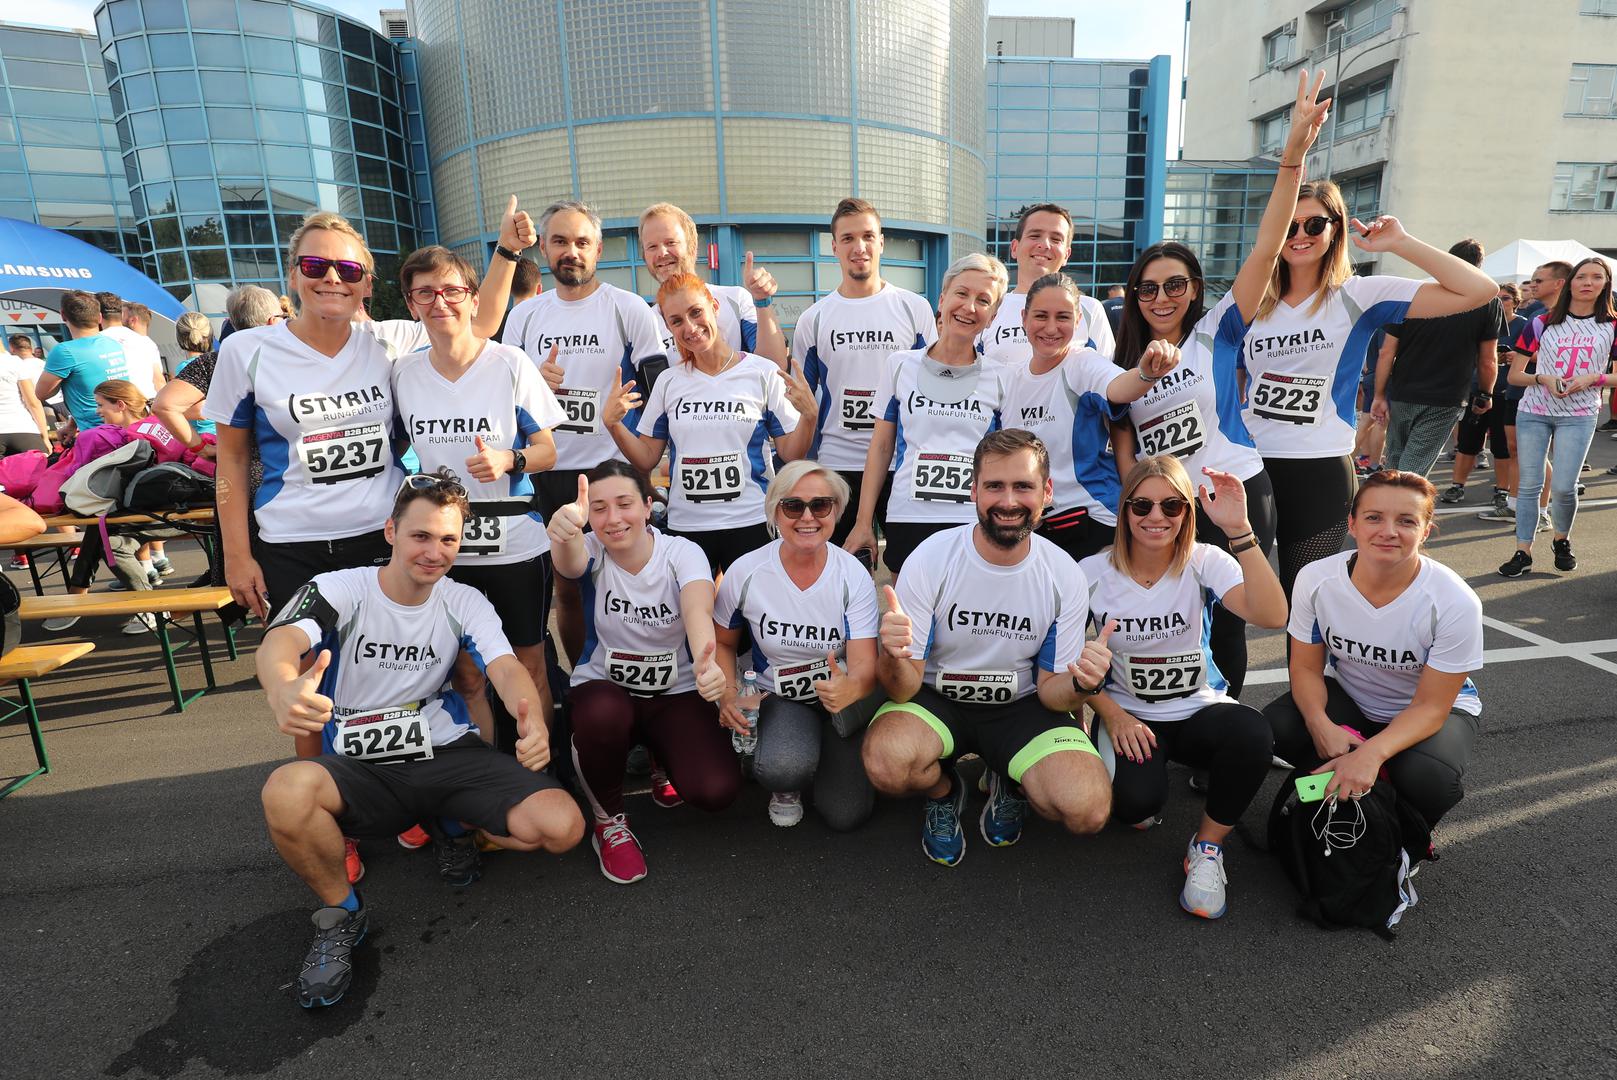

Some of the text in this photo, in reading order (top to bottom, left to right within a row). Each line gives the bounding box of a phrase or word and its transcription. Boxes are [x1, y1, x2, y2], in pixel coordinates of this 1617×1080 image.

[1267, 342, 1335, 358] RUN4FUN TEAM
[1308, 378, 1326, 387] RUN
[1144, 374, 1206, 407] RUN4FUN TEAM
[1254, 384, 1322, 413] 5223
[928, 409, 966, 419] RUN4FUN
[1177, 404, 1195, 416] RUN
[345, 428, 362, 438] B2B
[362, 424, 381, 434] RUN
[1142, 416, 1202, 456] 5222
[428, 435, 472, 445] RUN4FUN
[306, 438, 384, 473] 5237
[723, 453, 739, 463] RUN
[681, 466, 741, 491] 5219
[915, 465, 974, 491] 5252
[971, 628, 1038, 641] RUN4FUN TEAM
[1126, 623, 1192, 642] RUN4FUN TEAM
[781, 640, 824, 650] RUN4FUN
[1166, 656, 1182, 664] B2B
[1183, 653, 1200, 662] RUN
[379, 661, 421, 672] RUN4FUN
[610, 664, 673, 686] 5247
[979, 675, 995, 683] B2B
[995, 675, 1013, 684] RUN
[1131, 666, 1201, 690] 5227
[942, 685, 1012, 702] 5230
[383, 710, 401, 720] B2B
[343, 721, 425, 757] 5224
